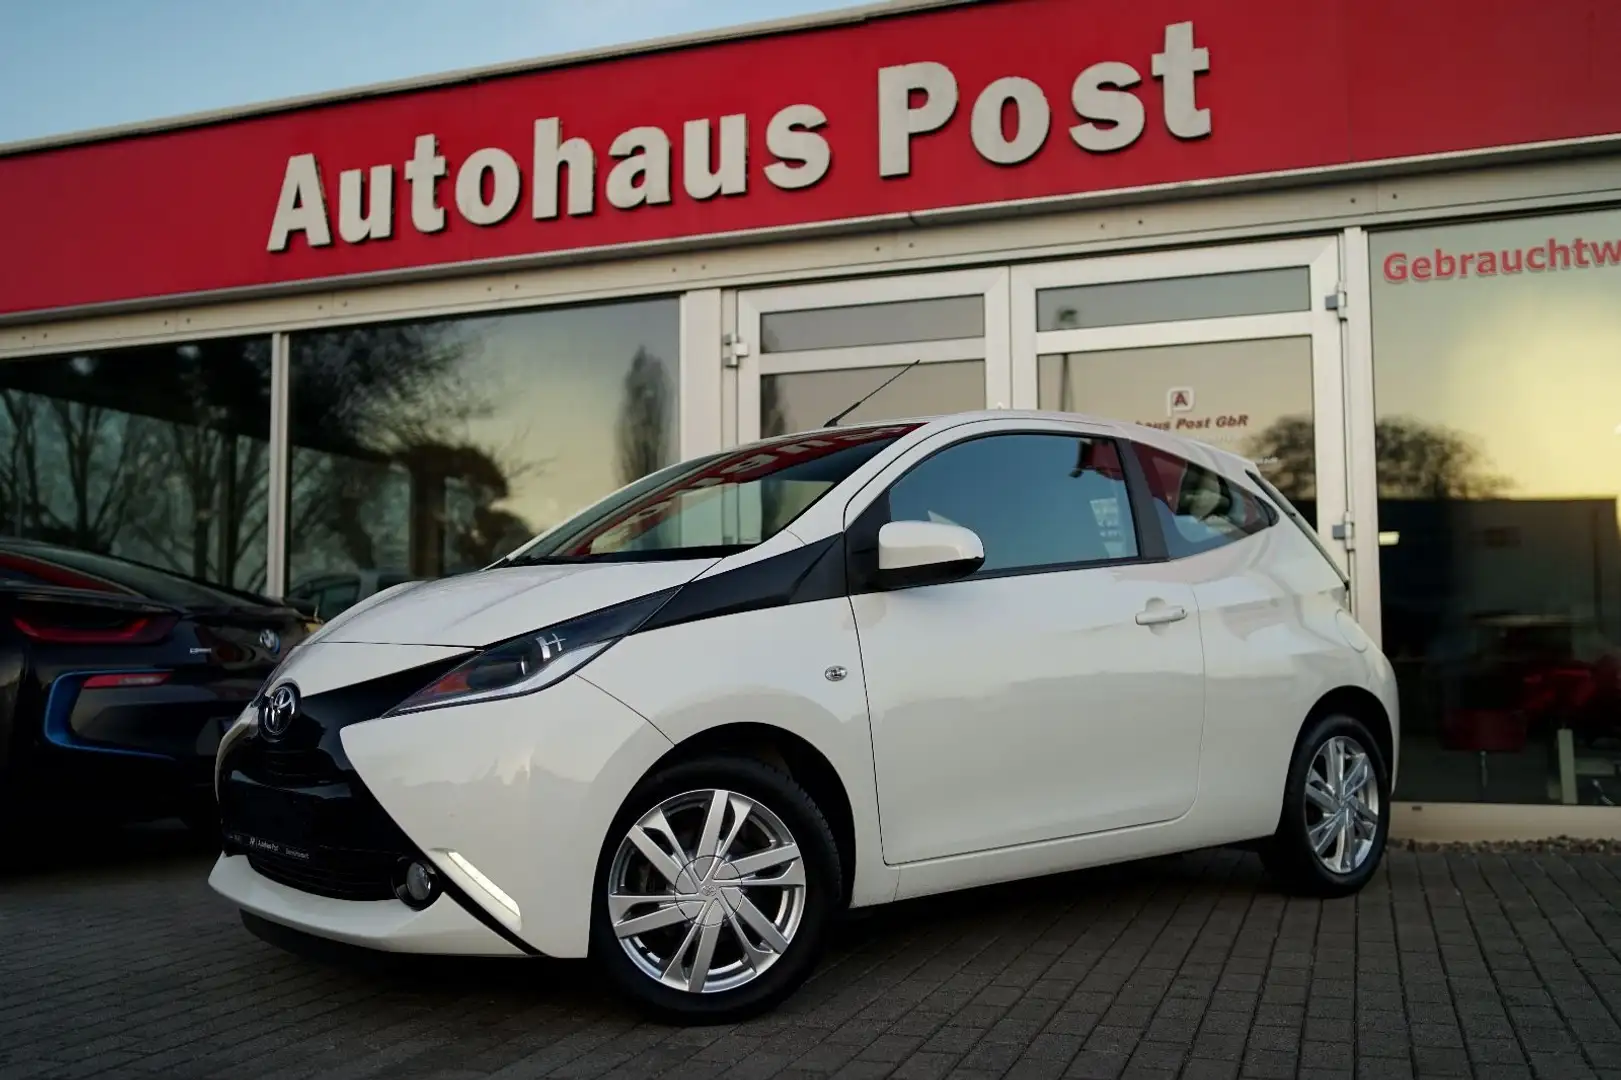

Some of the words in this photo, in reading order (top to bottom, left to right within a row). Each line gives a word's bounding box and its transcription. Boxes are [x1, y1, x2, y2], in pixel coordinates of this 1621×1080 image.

[266, 105, 832, 252] Autohaus
[878, 21, 1212, 178] Post
[1383, 238, 1621, 282] Gebrauchtw
[1176, 418, 1211, 430] Post
[1216, 414, 1249, 429] GbR
